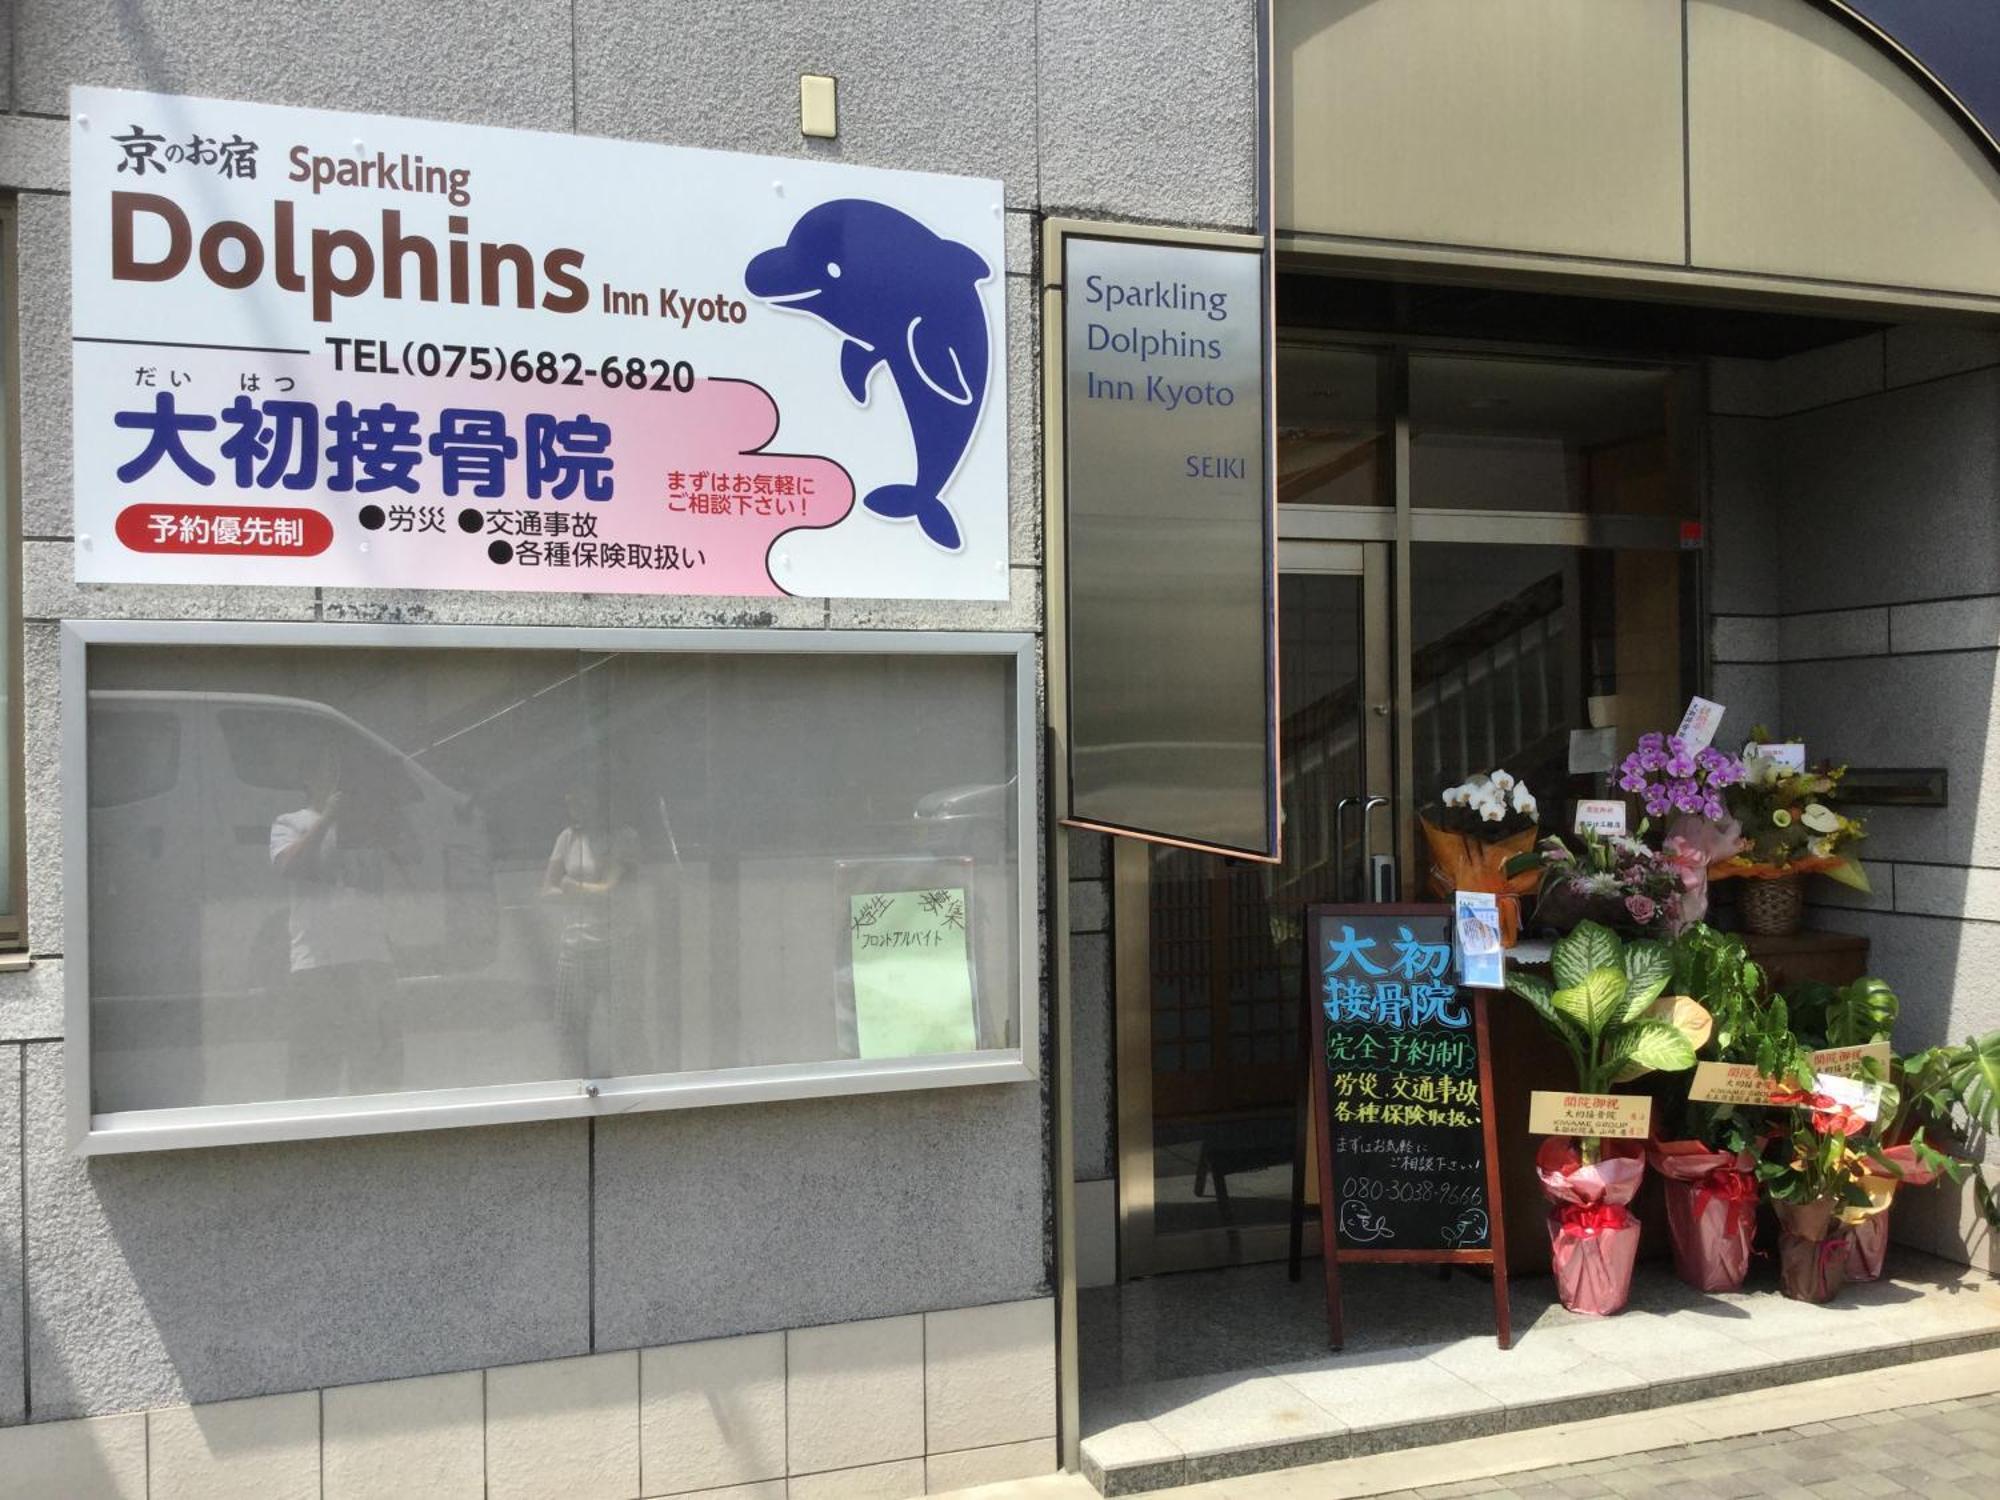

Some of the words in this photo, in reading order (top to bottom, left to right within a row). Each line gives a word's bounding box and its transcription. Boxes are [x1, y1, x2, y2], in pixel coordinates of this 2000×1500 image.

[111, 125, 259, 181] 京のお宿
[288, 145, 471, 207] Sparkling
[111, 191, 590, 323] Dolphins
[602, 284, 649, 317] Inn
[659, 288, 747, 328] Kyoto
[1086, 275, 1228, 321] Sparkling
[1087, 324, 1222, 362] Dolphins
[1087, 371, 1133, 401] Inn
[1146, 375, 1234, 411] Kyoto
[114, 391, 614, 501] 大初接骨院
[667, 471, 815, 495] まずはお気軽に
[1186, 455, 1246, 479] SEIKI
[147, 514, 305, 548] 予約優先制
[389, 505, 446, 533] 労災
[486, 509, 598, 538] 交通事故
[515, 540, 706, 570] 各種保険取扱い
[862, 930, 943, 949] フロントアルバイト
[1323, 925, 1453, 979] 大初
[1323, 977, 1471, 1030] 接骨院
[1329, 1033, 1464, 1068] 完全予約制
[1334, 1101, 1481, 1127] 各種保険取扱い
